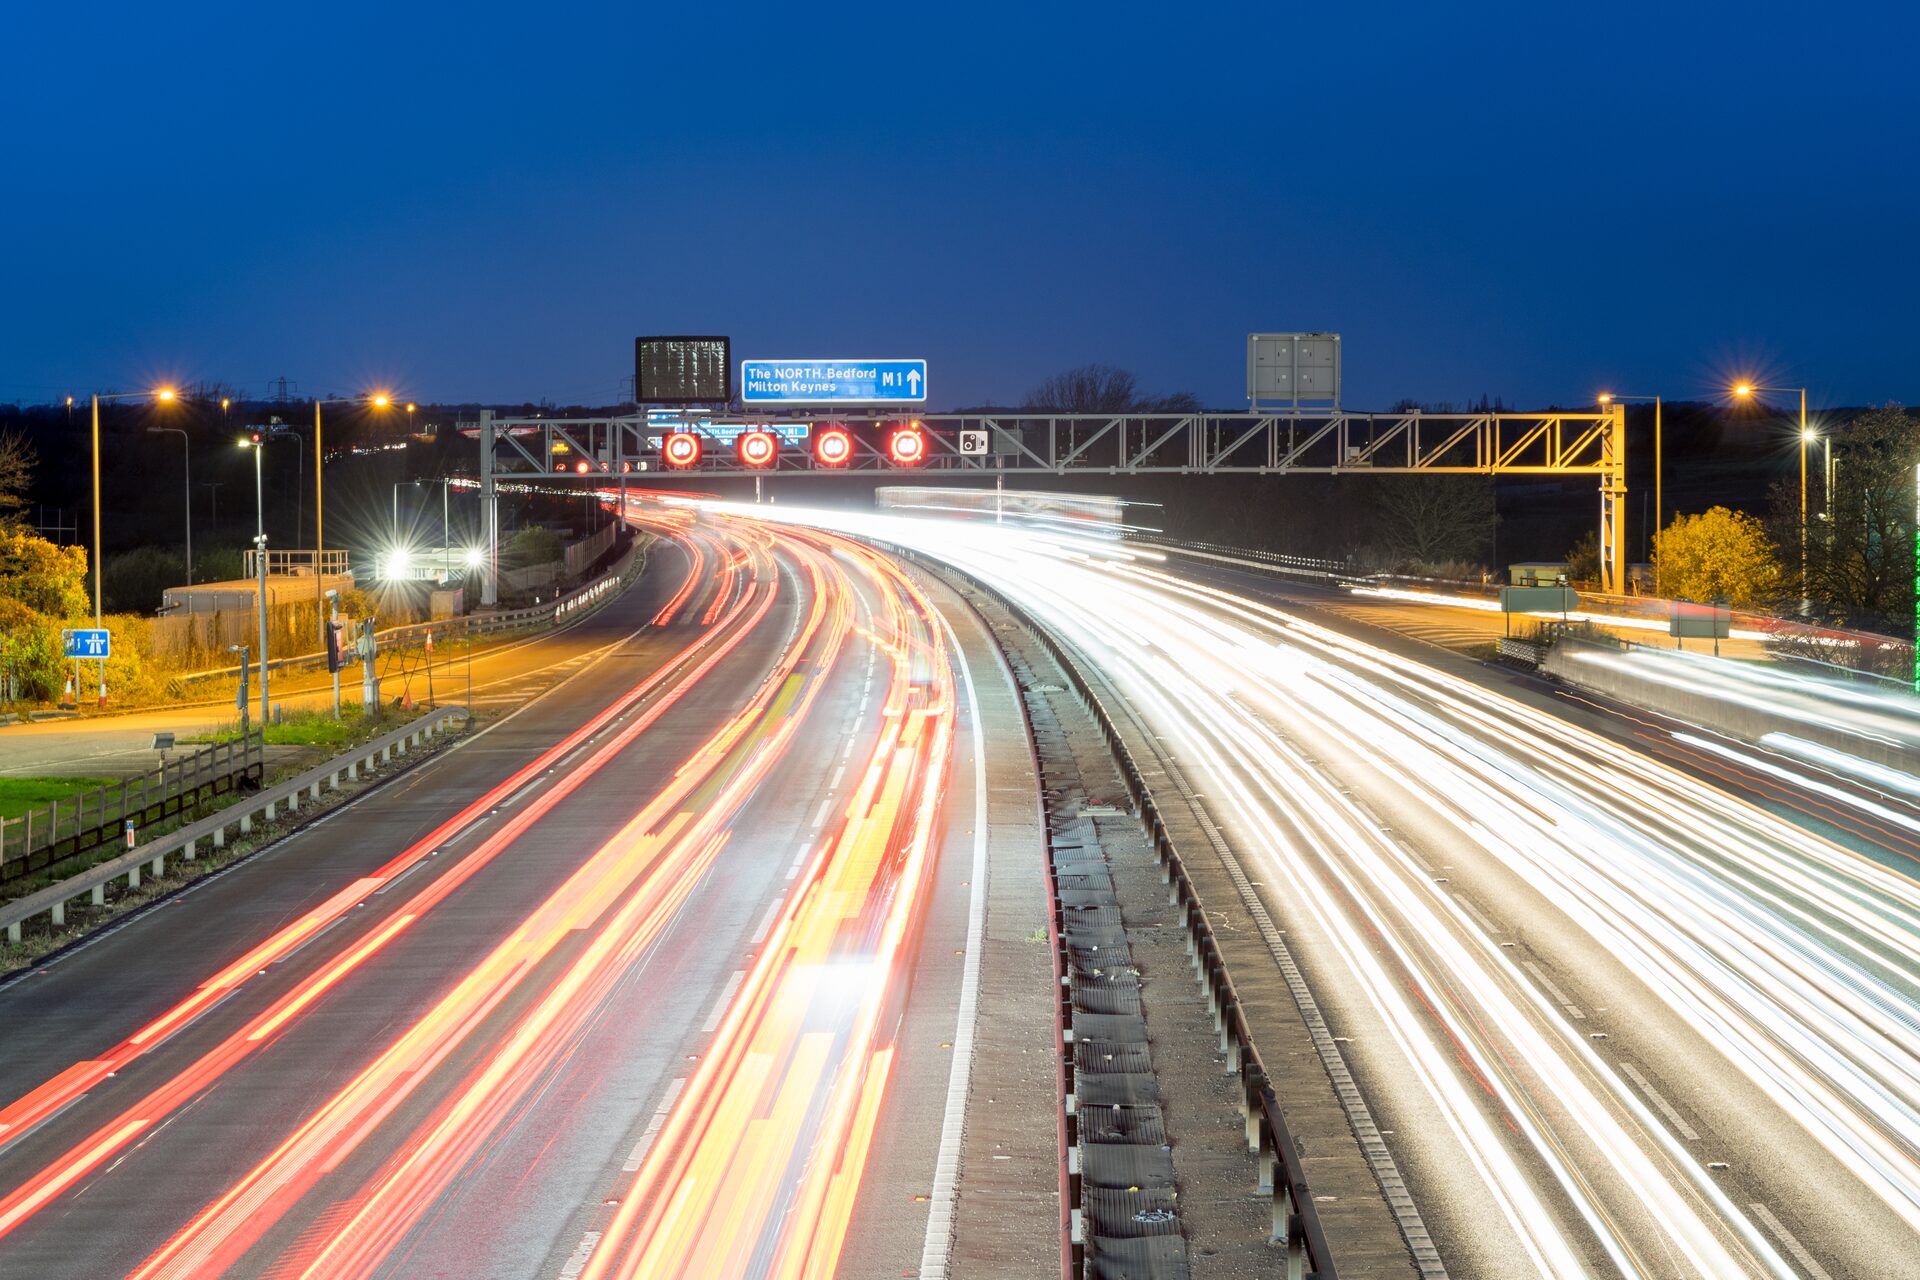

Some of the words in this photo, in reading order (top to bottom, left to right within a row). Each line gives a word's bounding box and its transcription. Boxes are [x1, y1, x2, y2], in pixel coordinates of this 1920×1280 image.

[749, 368, 771, 379] The
[827, 367, 877, 379] Bedford
[882, 372, 902, 387] M1
[748, 381, 788, 392] Milton
[791, 381, 836, 394] Keynes
